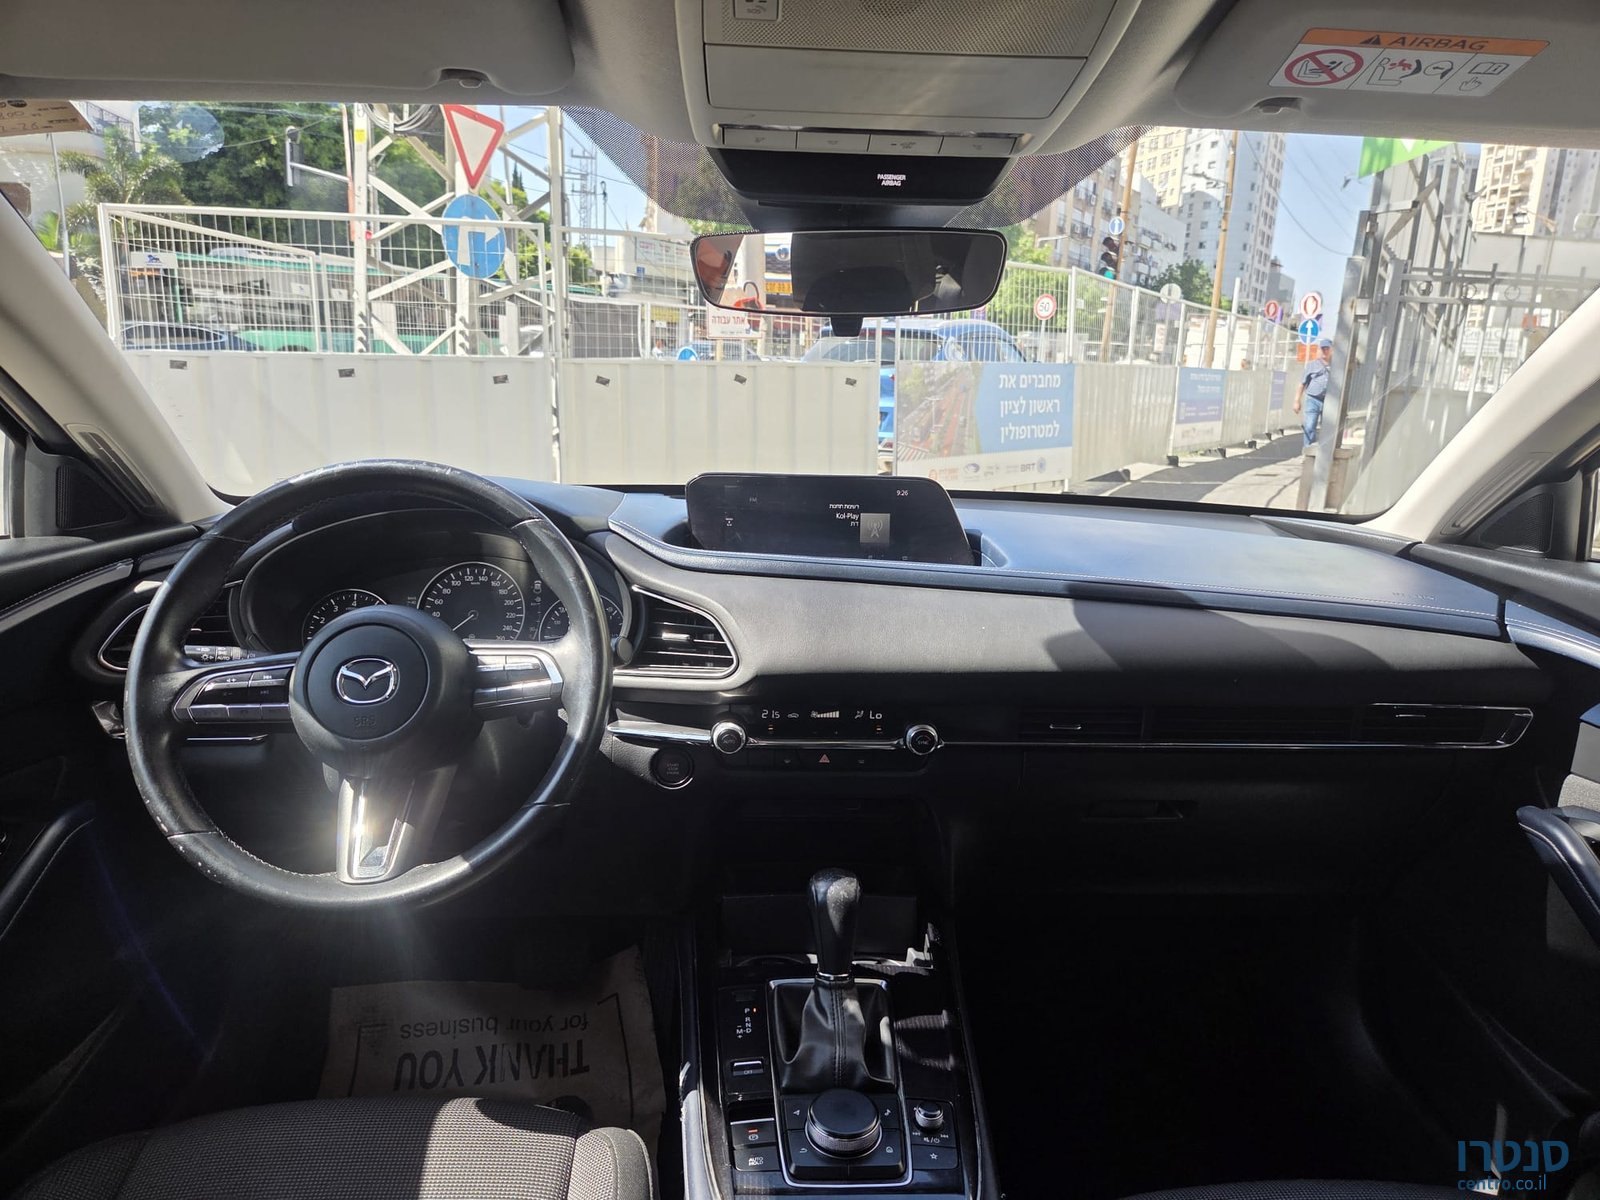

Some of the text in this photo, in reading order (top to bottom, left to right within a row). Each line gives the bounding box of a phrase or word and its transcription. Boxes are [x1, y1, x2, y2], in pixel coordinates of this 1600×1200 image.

[1387, 36, 1489, 51] AIRBAG
[876, 173, 907, 181] PASSENGER
[1039, 301, 1050, 312] 50
[711, 315, 746, 325] אתר עבודה
[999, 374, 1061, 389] מחברים את
[1000, 396, 1061, 418] ראשון לציון
[1000, 420, 1060, 443] למטרופולין
[1020, 462, 1036, 473] BRT
[869, 710, 883, 719] Lo
[400, 1011, 589, 1040] for your business
[393, 1039, 591, 1091] THANK YOU
